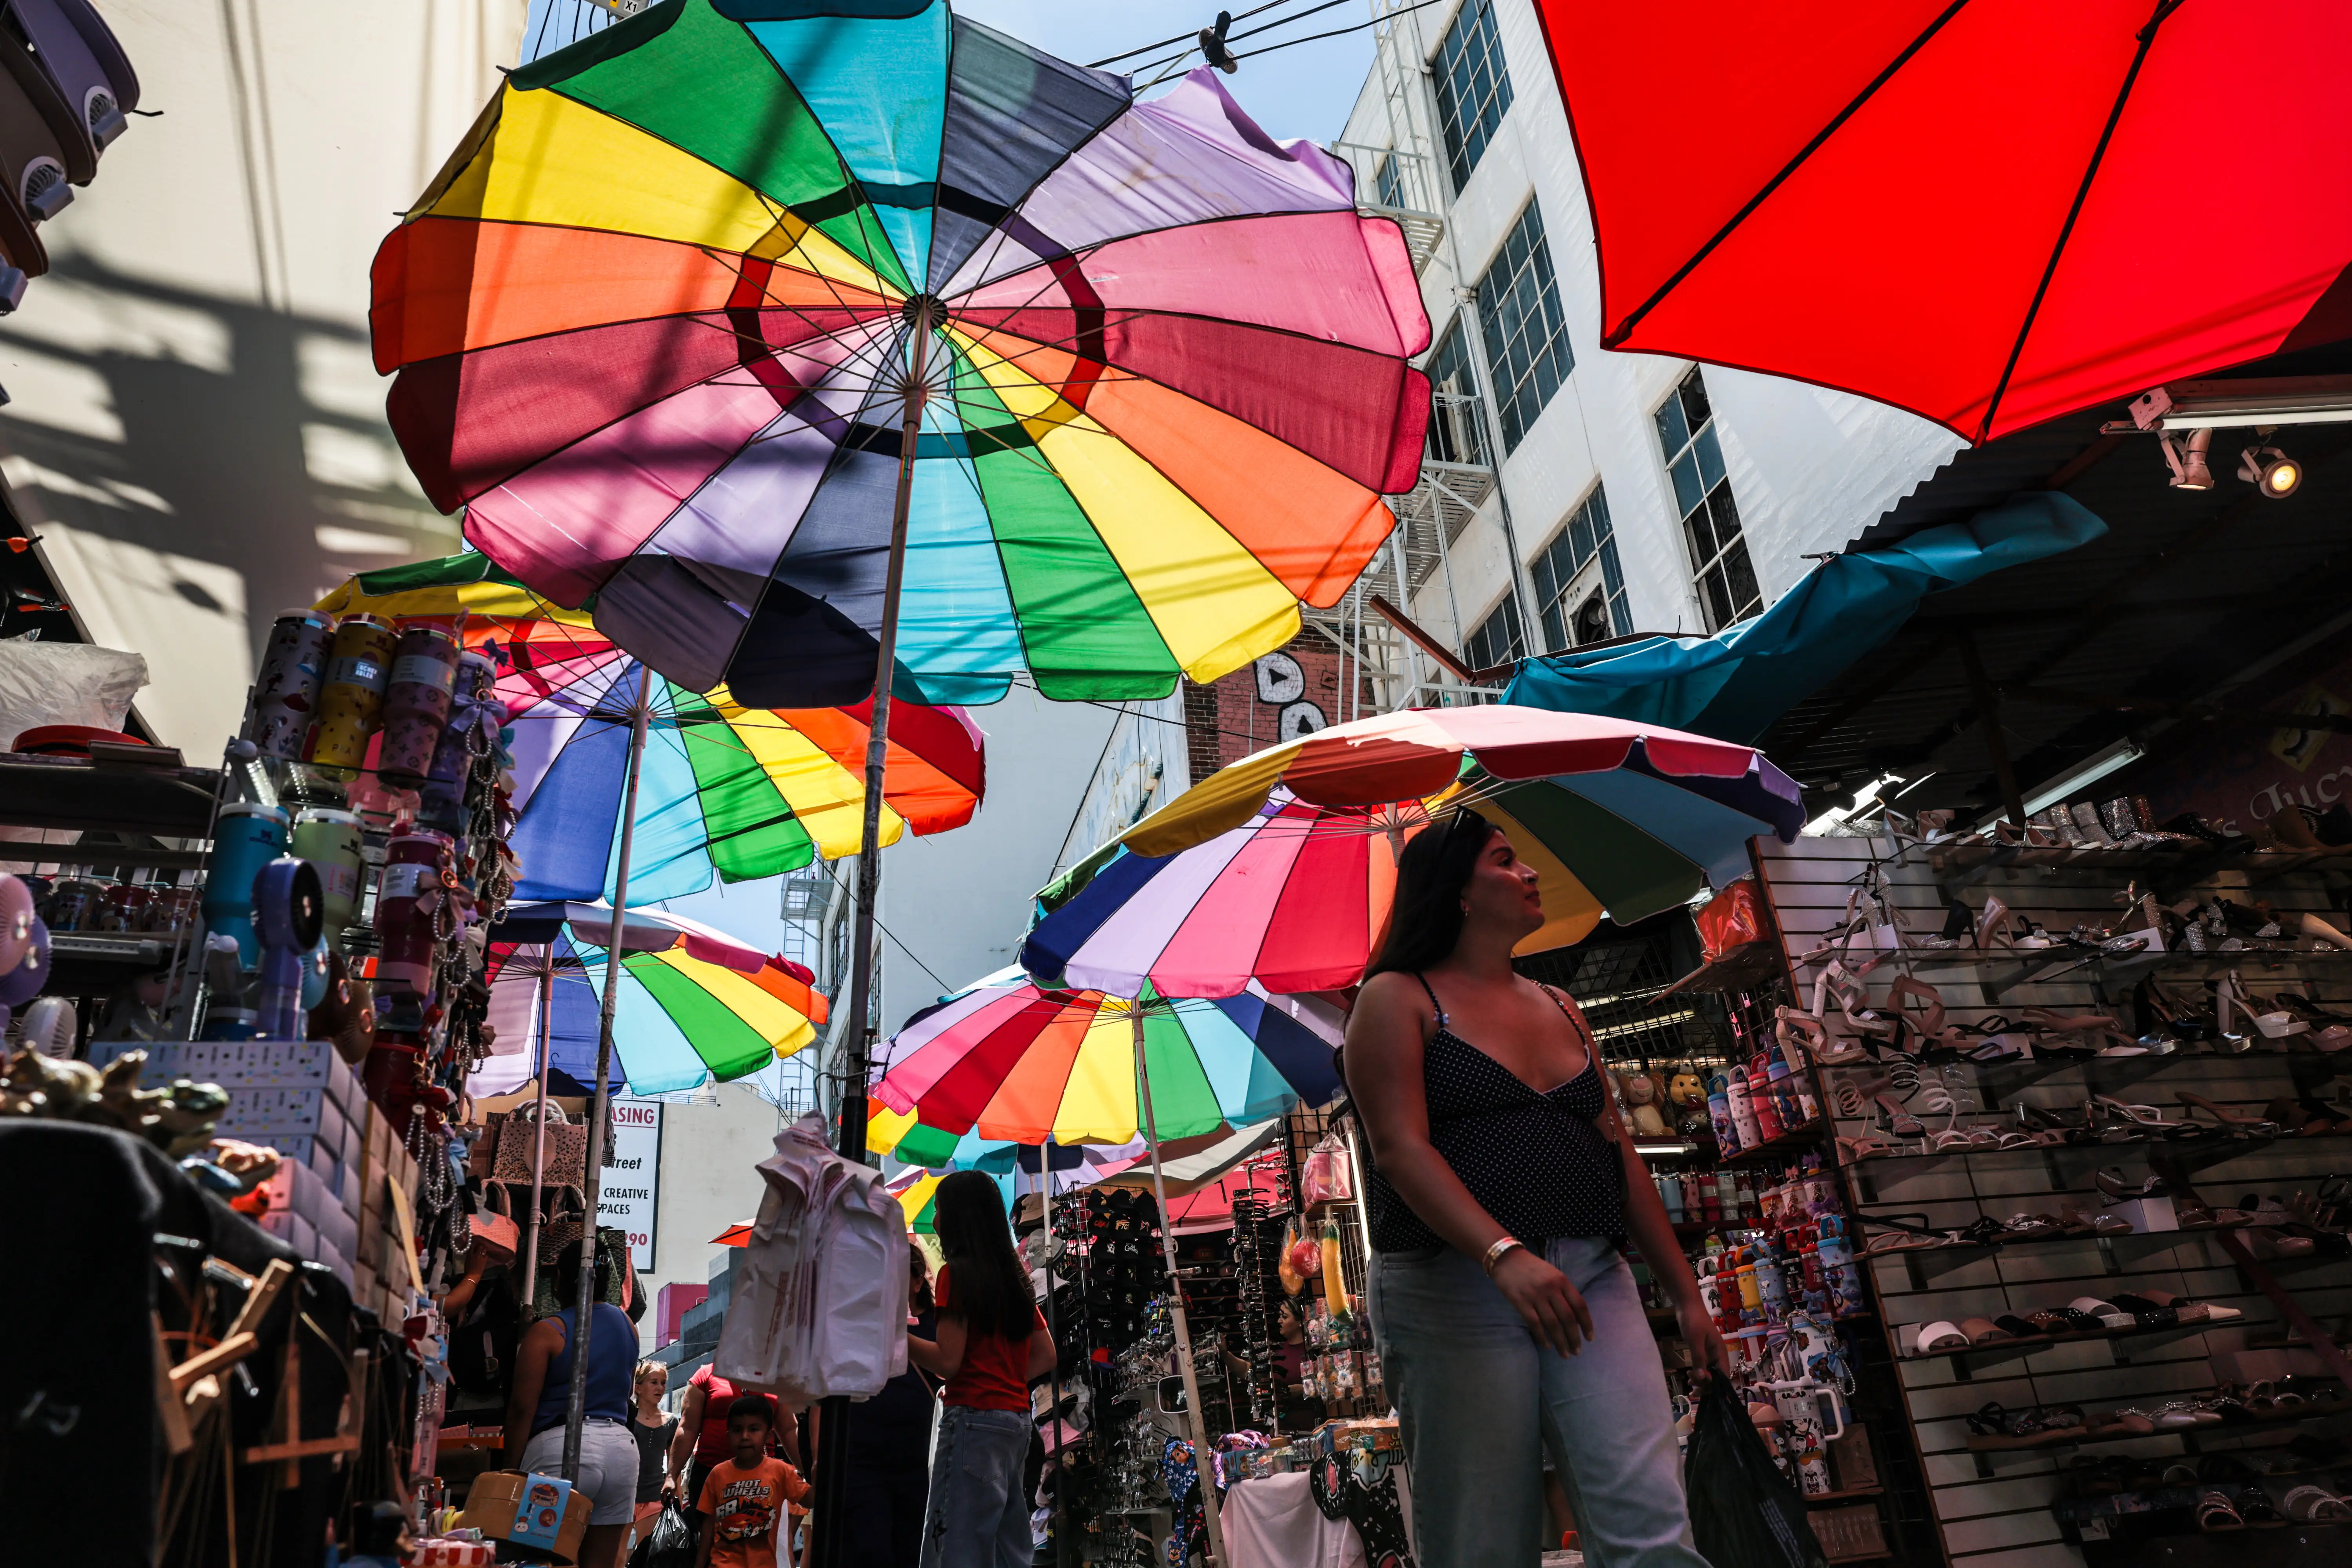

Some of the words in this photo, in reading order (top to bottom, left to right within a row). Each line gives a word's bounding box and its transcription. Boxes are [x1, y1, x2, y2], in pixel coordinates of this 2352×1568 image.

[608, 1156, 642, 1169] treet
[604, 1187, 649, 1200] CREATIVE
[734, 1479, 761, 1489] HOT
[723, 1486, 770, 1499] WHEELS
